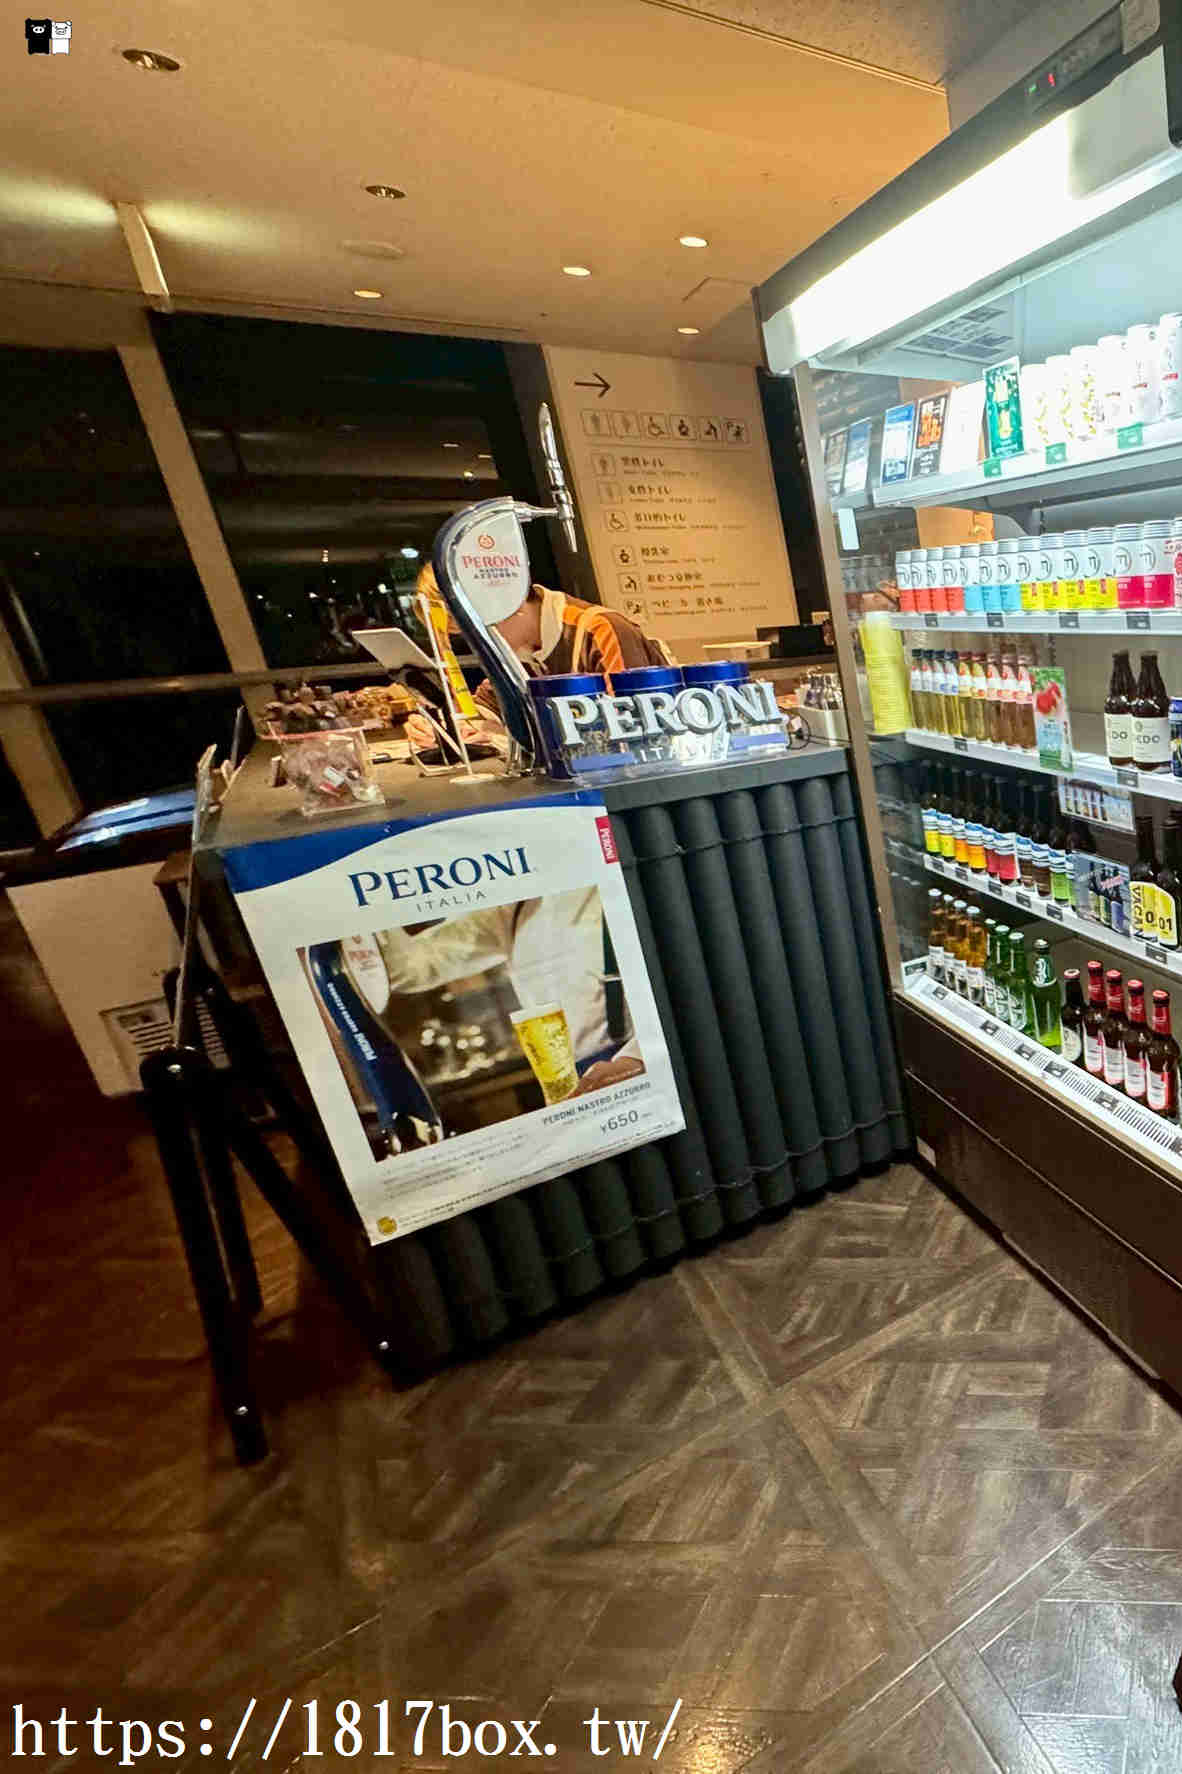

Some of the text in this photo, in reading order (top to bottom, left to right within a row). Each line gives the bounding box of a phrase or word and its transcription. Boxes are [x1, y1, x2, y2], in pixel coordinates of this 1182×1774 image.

[551, 681, 787, 749] PERONI
[599, 826, 614, 861] PERONI
[347, 845, 532, 907] PERONI
[415, 890, 487, 913] ITALIA
[1158, 916, 1174, 933] 01
